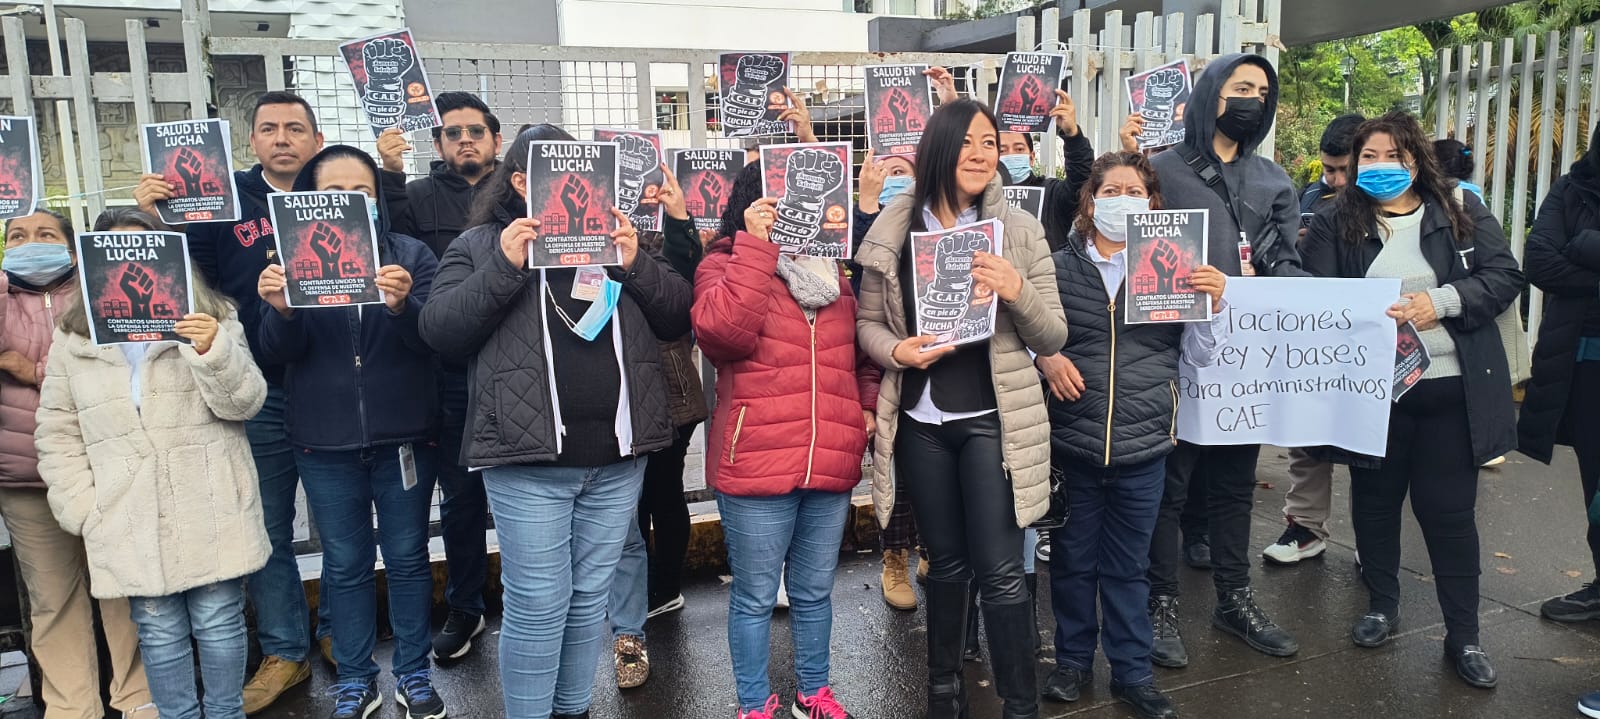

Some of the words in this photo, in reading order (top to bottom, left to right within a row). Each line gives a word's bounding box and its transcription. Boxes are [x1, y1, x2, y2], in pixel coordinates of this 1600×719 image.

[1012, 54, 1039, 65] SALUD
[1040, 55, 1052, 65] EN
[873, 67, 902, 77] SALUD
[904, 66, 916, 76] EN
[1016, 64, 1045, 74] LUCHA
[880, 77, 912, 87] LUCHA
[0, 119, 12, 131] N
[156, 124, 192, 137] SALUD
[193, 122, 209, 134] EN
[165, 134, 204, 147] LUCHA
[541, 144, 582, 158] SALUD
[584, 145, 600, 158] EN
[684, 151, 717, 160] SALUD
[719, 151, 732, 160] EN
[551, 159, 594, 172] LUCHA
[691, 160, 726, 170] LUCHA
[284, 195, 328, 208] SALUD
[332, 194, 349, 206] EN
[1016, 189, 1029, 200] EN
[296, 207, 344, 221] LUCHA
[1133, 214, 1170, 226] SALUD
[1173, 213, 1188, 225] EN
[233, 217, 274, 247] CHA
[1141, 226, 1182, 238] LUCHA
[94, 235, 142, 248] SALUD
[146, 234, 165, 247] EN
[106, 248, 159, 261] LUCHA
[1229, 304, 1352, 333] taciones
[1217, 346, 1248, 370] ey
[1262, 345, 1277, 368] y
[1287, 343, 1368, 369] bases
[1231, 373, 1387, 400] administrativos
